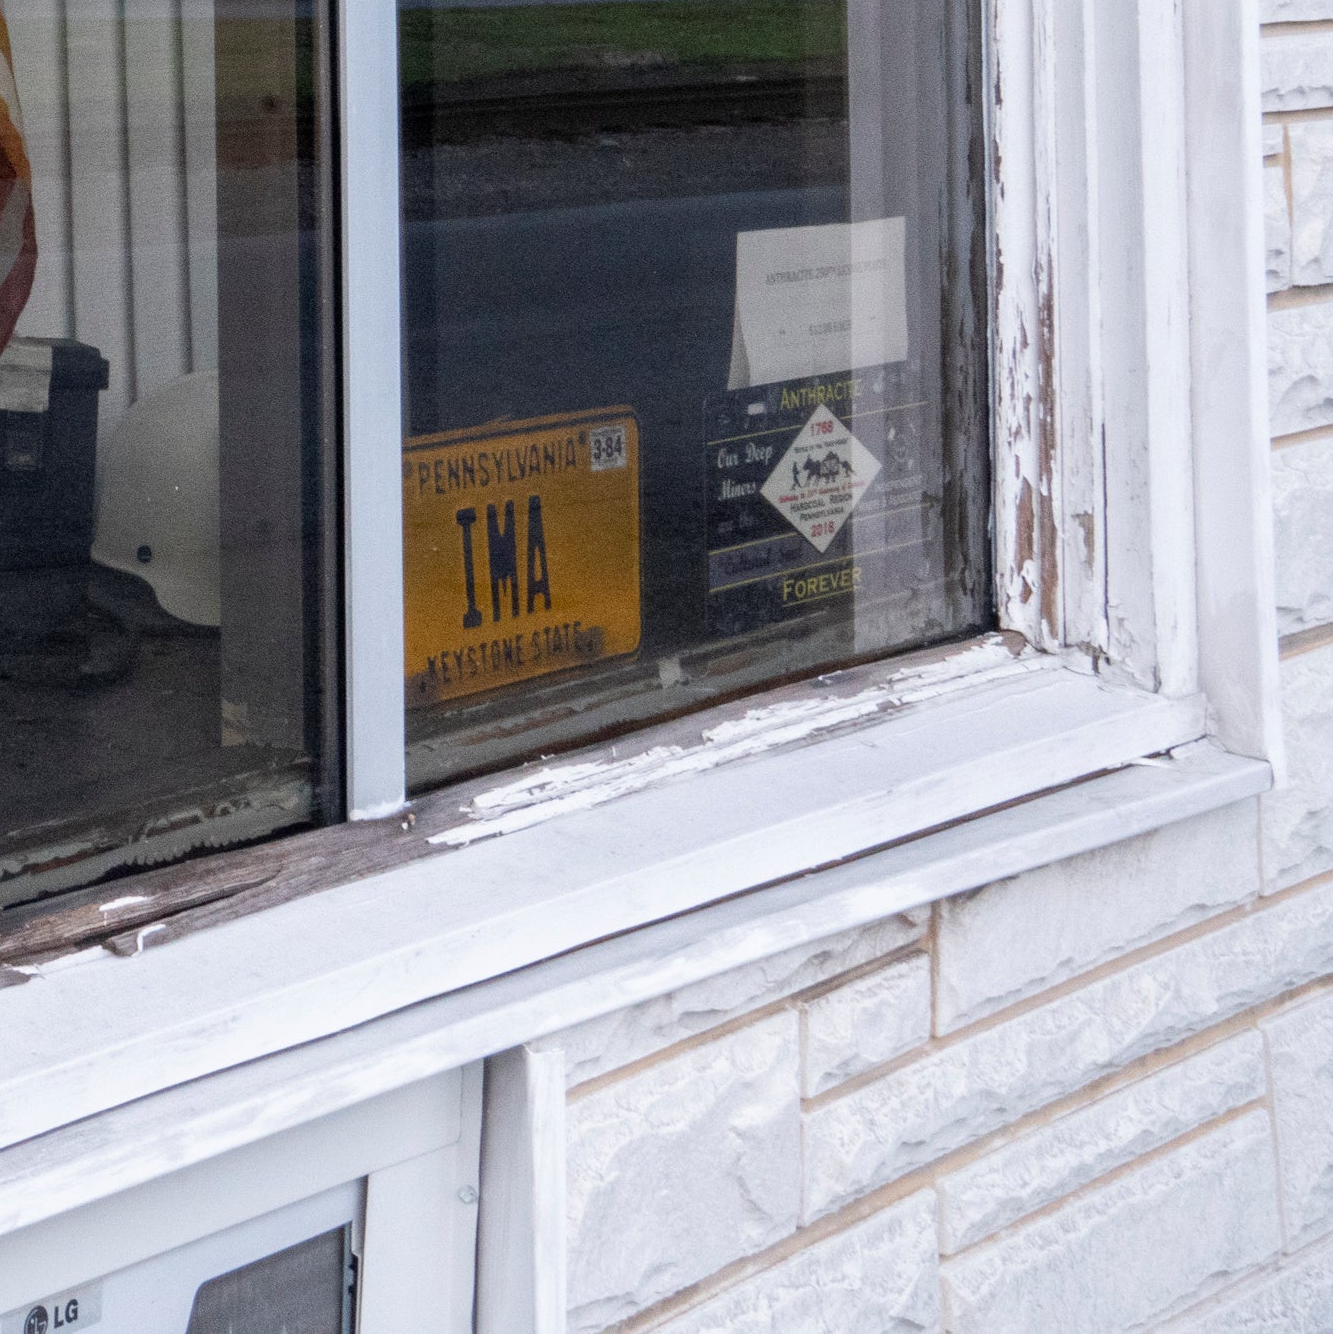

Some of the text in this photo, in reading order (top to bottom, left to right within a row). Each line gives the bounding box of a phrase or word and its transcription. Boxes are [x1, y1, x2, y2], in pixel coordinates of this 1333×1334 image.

[781, 379, 863, 410] ANTHRACITE
[809, 420, 834, 437] 1768
[418, 437, 577, 495] PENNSYLVANIA
[810, 521, 835, 539] 2018
[455, 494, 552, 630] IMA
[782, 566, 863, 601] FOREVER
[426, 620, 583, 684] KEYSTONE STATE
[53, 1298, 79, 1329] LG
